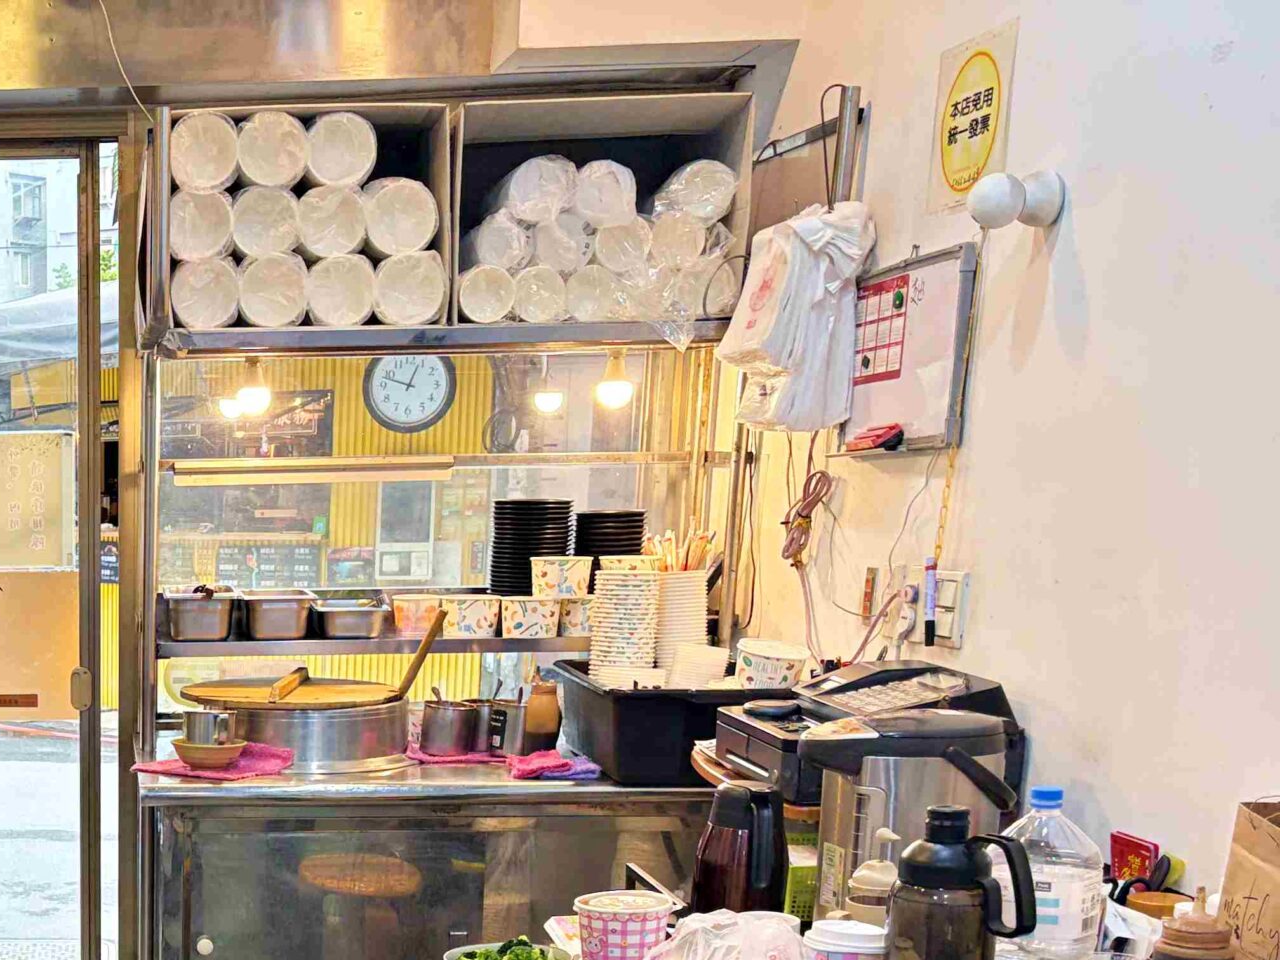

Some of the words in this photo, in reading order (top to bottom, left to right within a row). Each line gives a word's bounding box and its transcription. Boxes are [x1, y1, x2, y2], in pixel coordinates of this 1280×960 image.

[950, 87, 994, 121] 本店免用
[947, 113, 991, 146] 統一發票
[753, 660, 784, 676] HEALTHY
